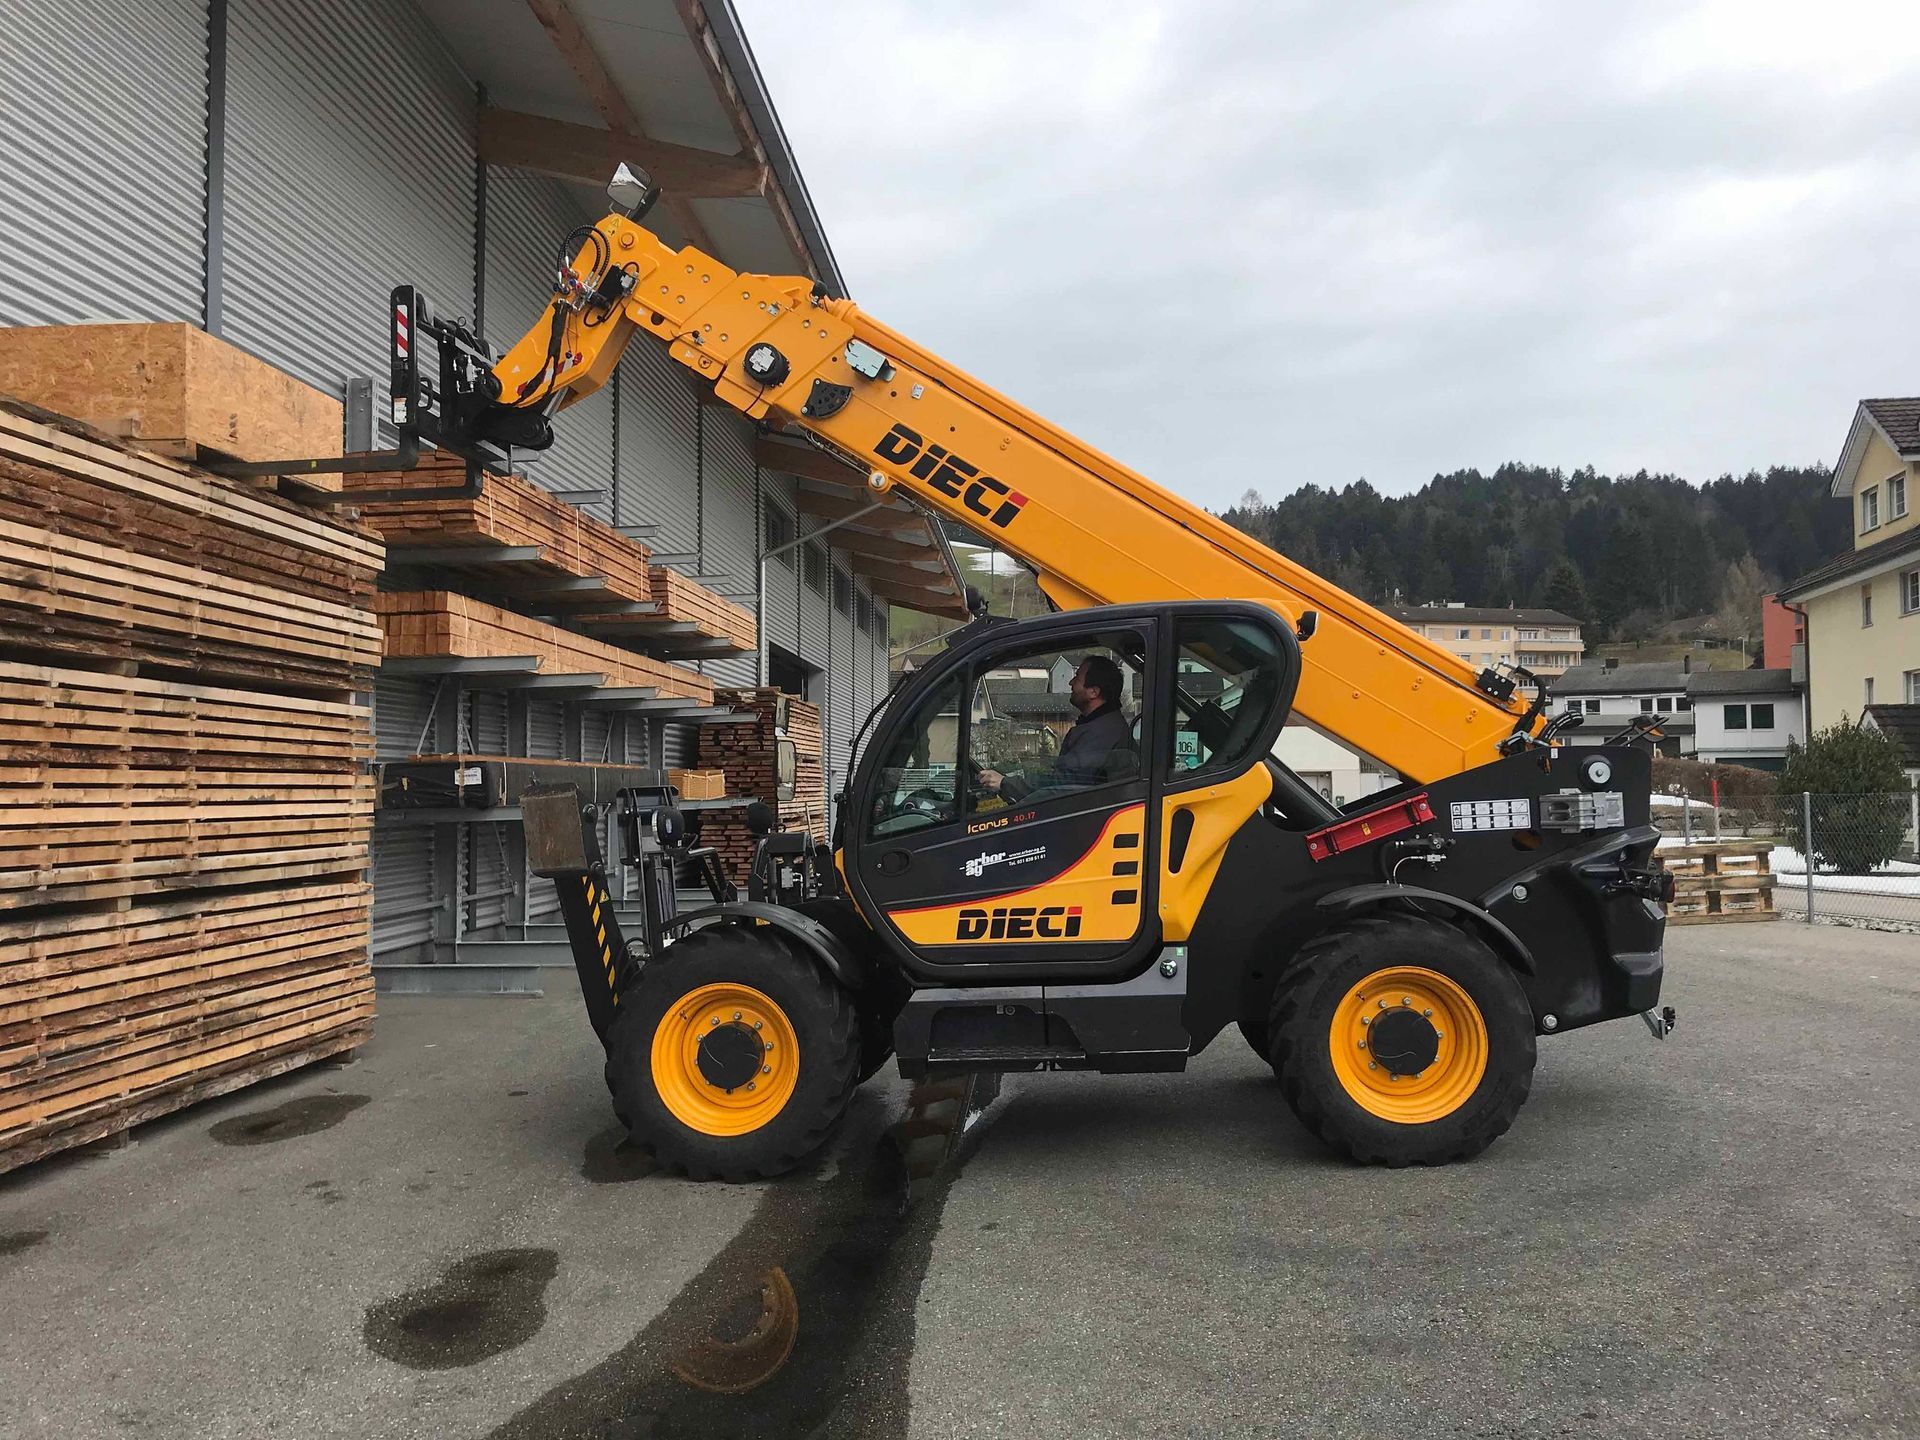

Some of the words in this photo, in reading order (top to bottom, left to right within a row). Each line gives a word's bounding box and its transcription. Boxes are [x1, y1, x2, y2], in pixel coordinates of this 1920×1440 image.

[873, 423, 1029, 528] DIECI
[1178, 741, 1193, 753] 106
[967, 817, 1009, 834] Icarus
[1013, 811, 1036, 822] 40.17
[965, 852, 1006, 868] arbor
[956, 906, 1082, 940] DIECI
